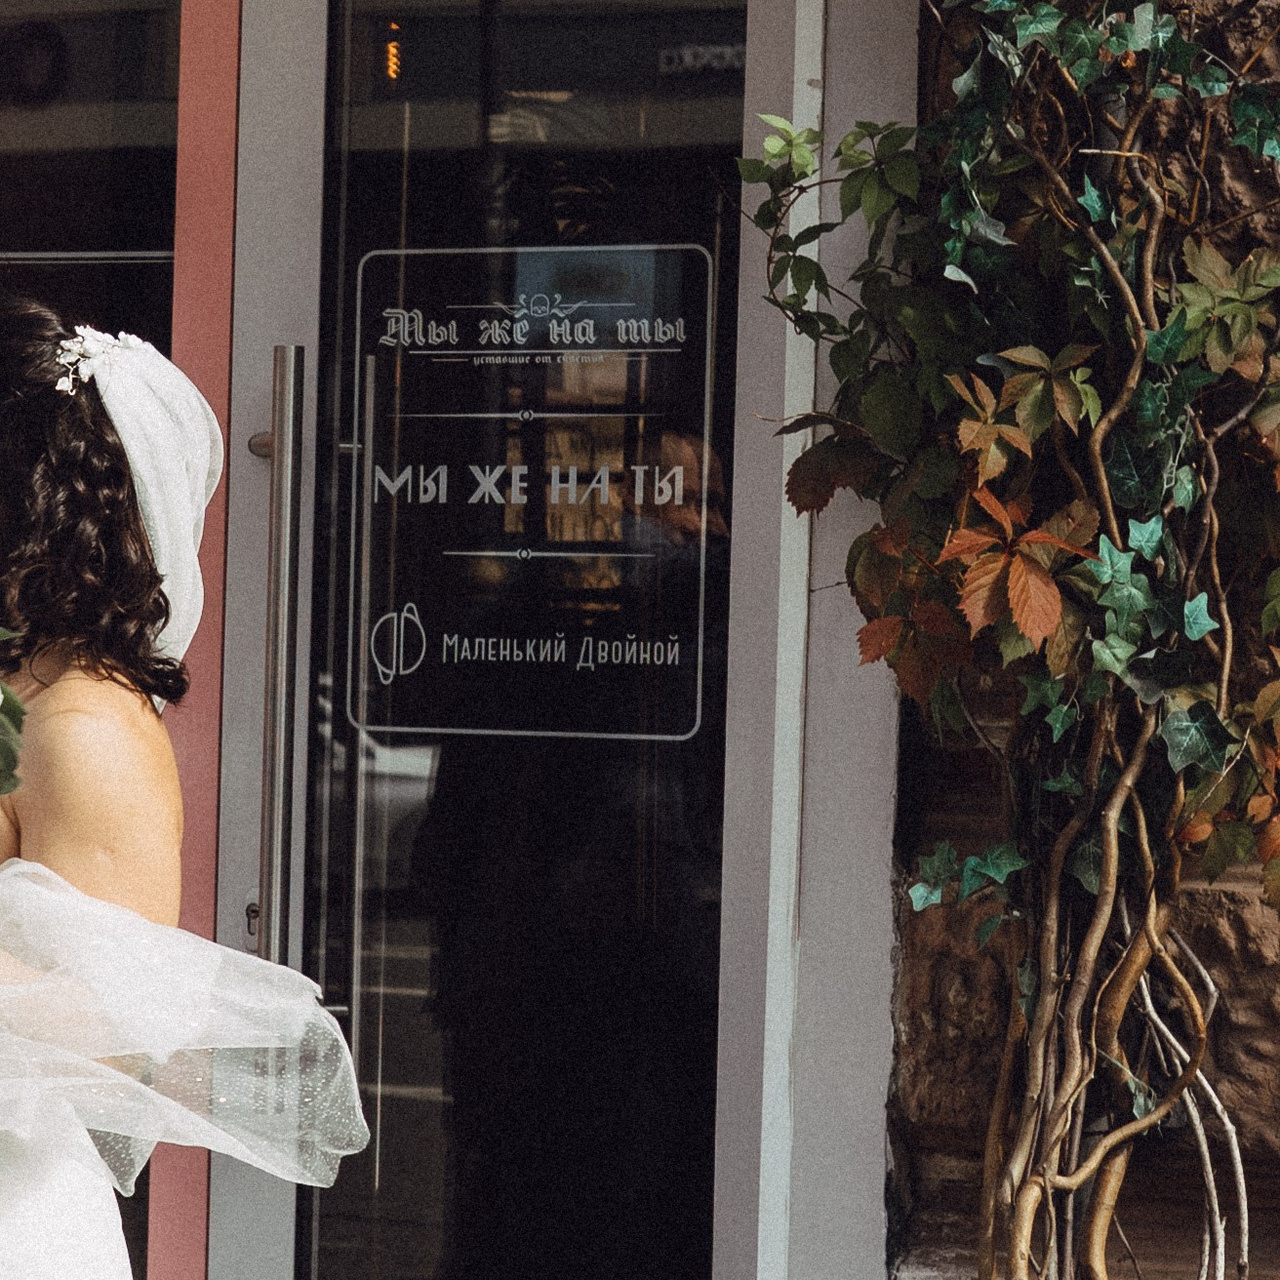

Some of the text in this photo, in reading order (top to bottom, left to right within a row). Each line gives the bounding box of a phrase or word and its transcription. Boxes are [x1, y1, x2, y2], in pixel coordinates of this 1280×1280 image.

[379, 308, 687, 347] Мы же на ты
[373, 464, 684, 506] МЫ ЖЕ НА ТЫ
